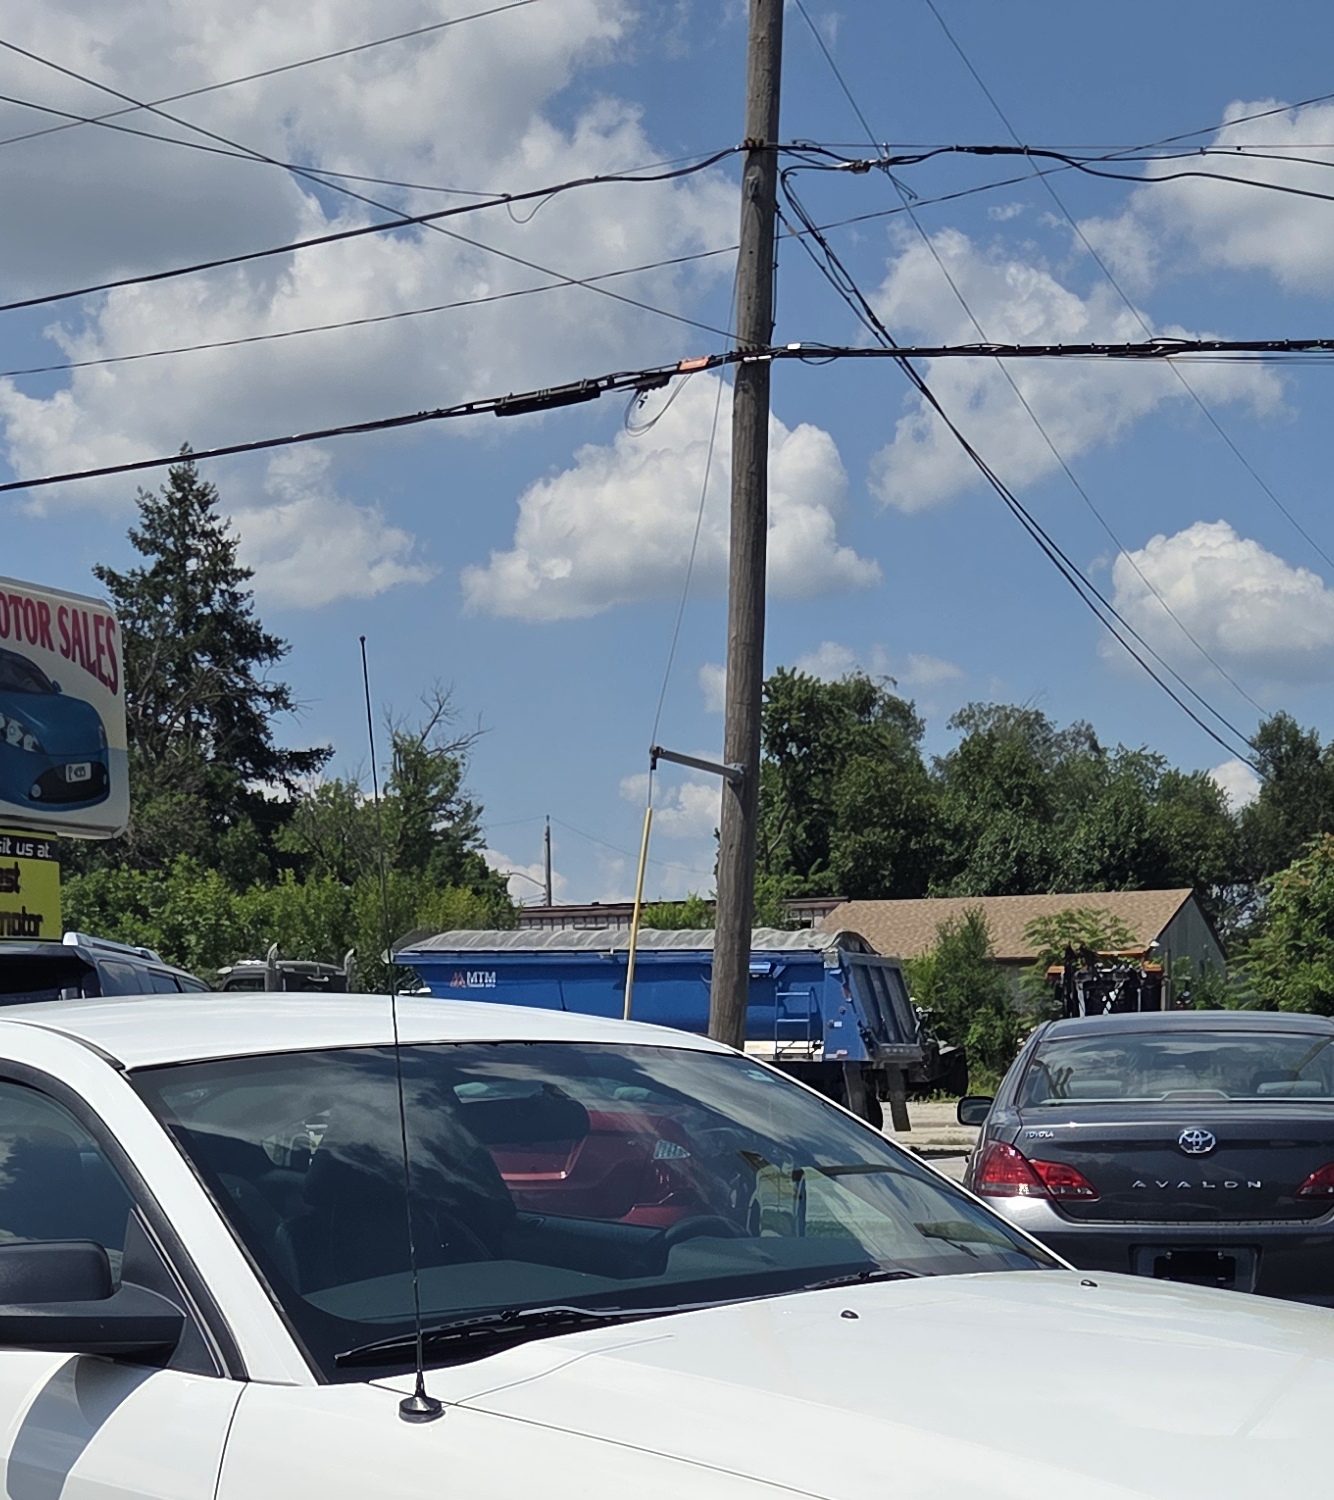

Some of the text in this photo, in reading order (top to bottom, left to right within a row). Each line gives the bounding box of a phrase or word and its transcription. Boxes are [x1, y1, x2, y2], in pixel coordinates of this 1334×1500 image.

[57, 606, 119, 696] SALES
[16, 842, 34, 857] us
[466, 971, 497, 983] MTM
[1131, 1179, 1263, 1189] AVALON
